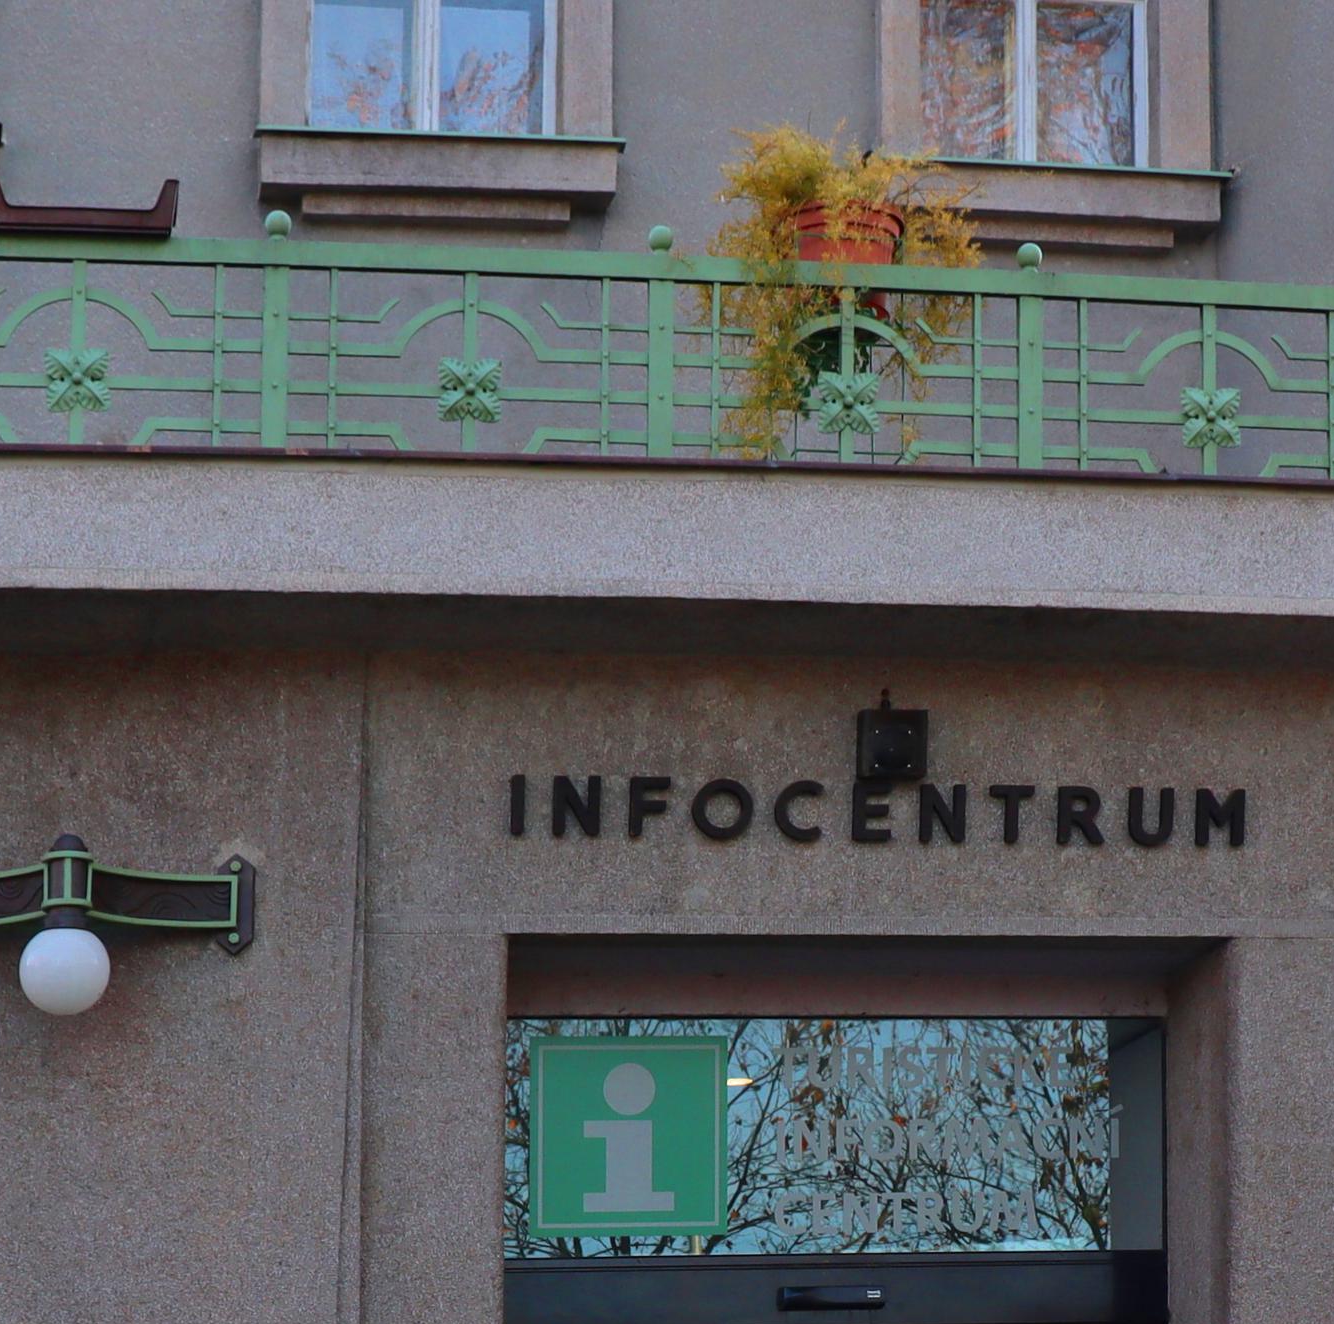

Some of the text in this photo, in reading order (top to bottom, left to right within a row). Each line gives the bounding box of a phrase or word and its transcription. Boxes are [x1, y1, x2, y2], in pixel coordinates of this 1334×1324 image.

[509, 773, 1247, 848] INFOCENTRUM
[772, 1030, 1075, 1089] TURISTICKÉ
[775, 1104, 1124, 1161] INFORMAČNÍ
[773, 1191, 1039, 1236] CENTRUM
